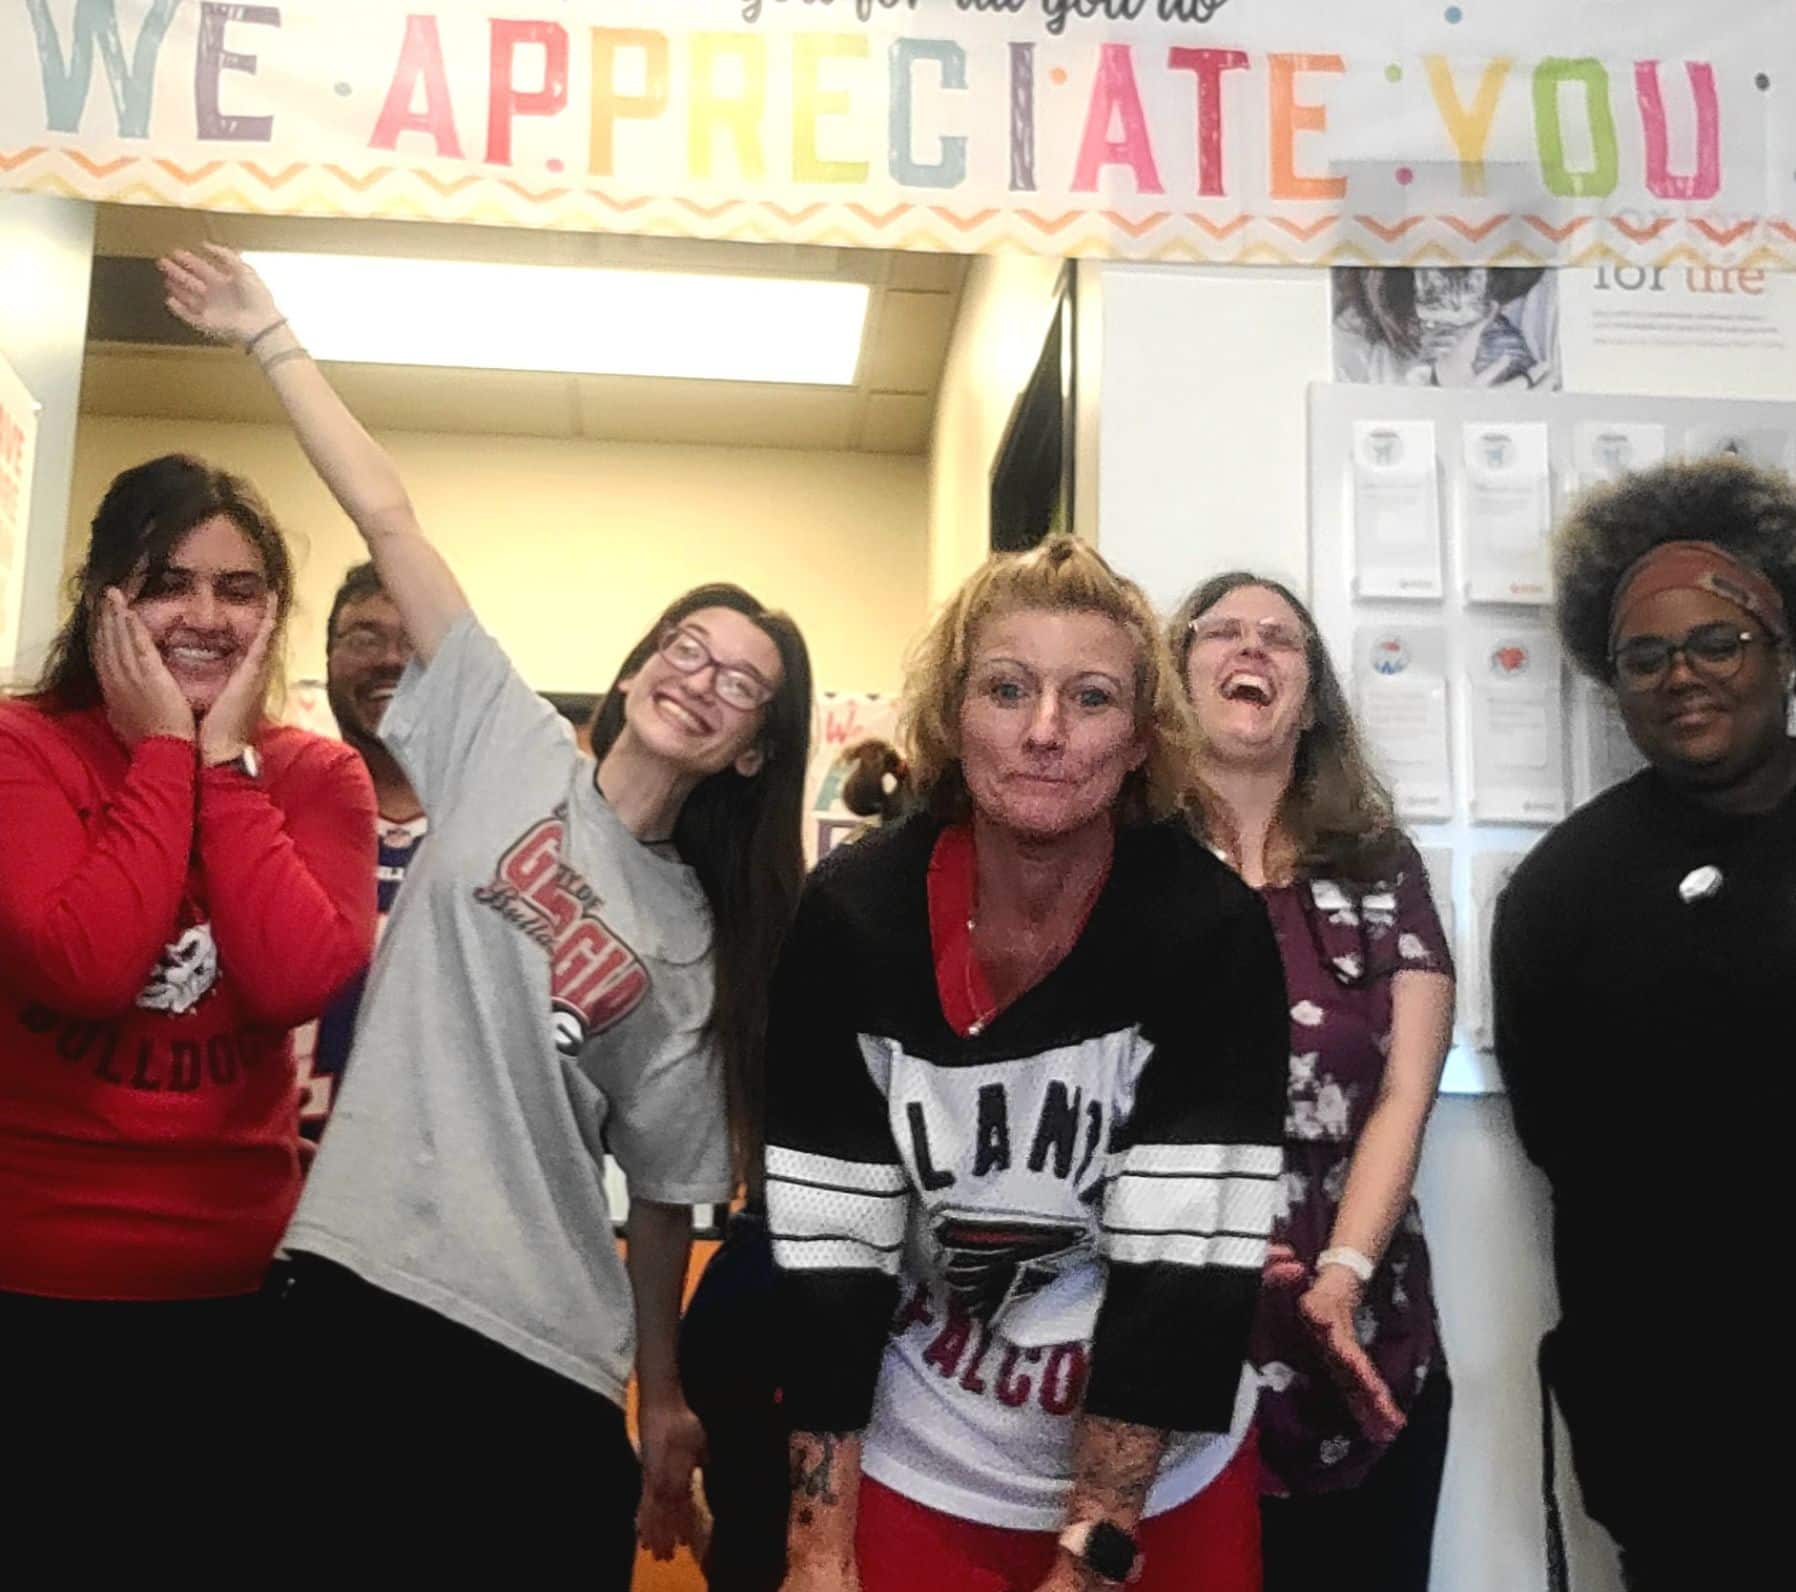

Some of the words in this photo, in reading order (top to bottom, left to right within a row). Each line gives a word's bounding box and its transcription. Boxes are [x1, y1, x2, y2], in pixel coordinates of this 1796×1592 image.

[27, 0, 282, 142] WE
[368, 14, 1346, 199] APPRECIATE
[1424, 55, 1720, 199] YOU
